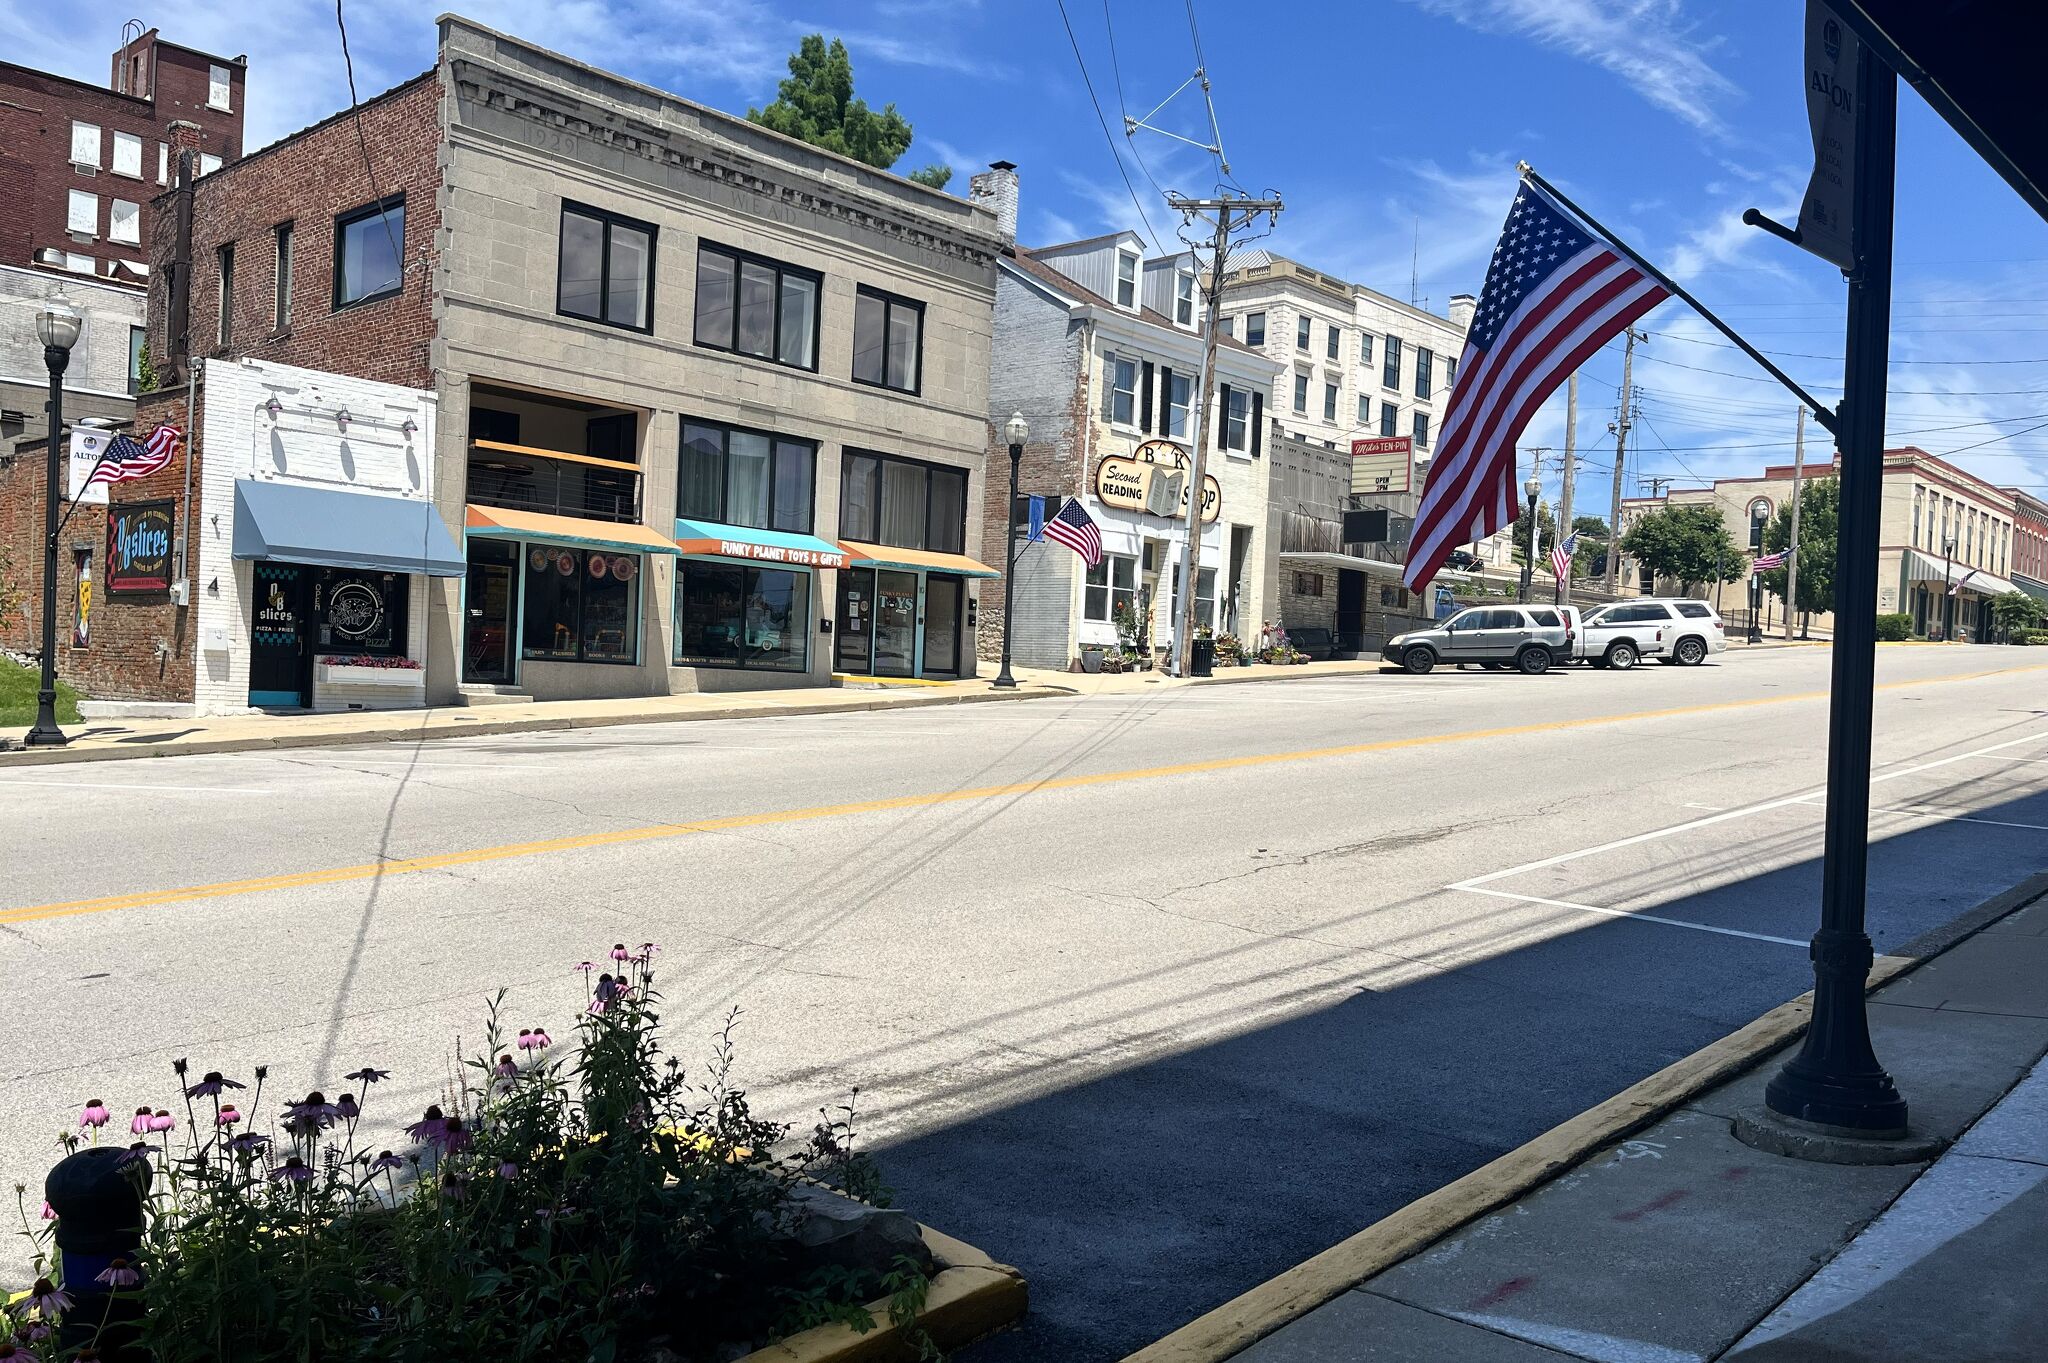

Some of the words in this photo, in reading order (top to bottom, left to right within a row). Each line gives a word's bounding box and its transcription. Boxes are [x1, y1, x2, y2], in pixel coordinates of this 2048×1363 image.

[1811, 70, 1852, 113] ALON
[1380, 441, 1408, 451] TEN-PIN
[1106, 465, 1142, 484] Second
[1102, 482, 1142, 499] READING
[1181, 485, 1216, 510] SOP
[721, 541, 751, 556] FUNKY
[753, 545, 786, 560] PLANET
[788, 549, 809, 563] TOYS
[811, 553, 818, 564] &
[820, 553, 843, 567] GIFTS
[207, 576, 219, 591] 4
[260, 608, 293, 620] slices
